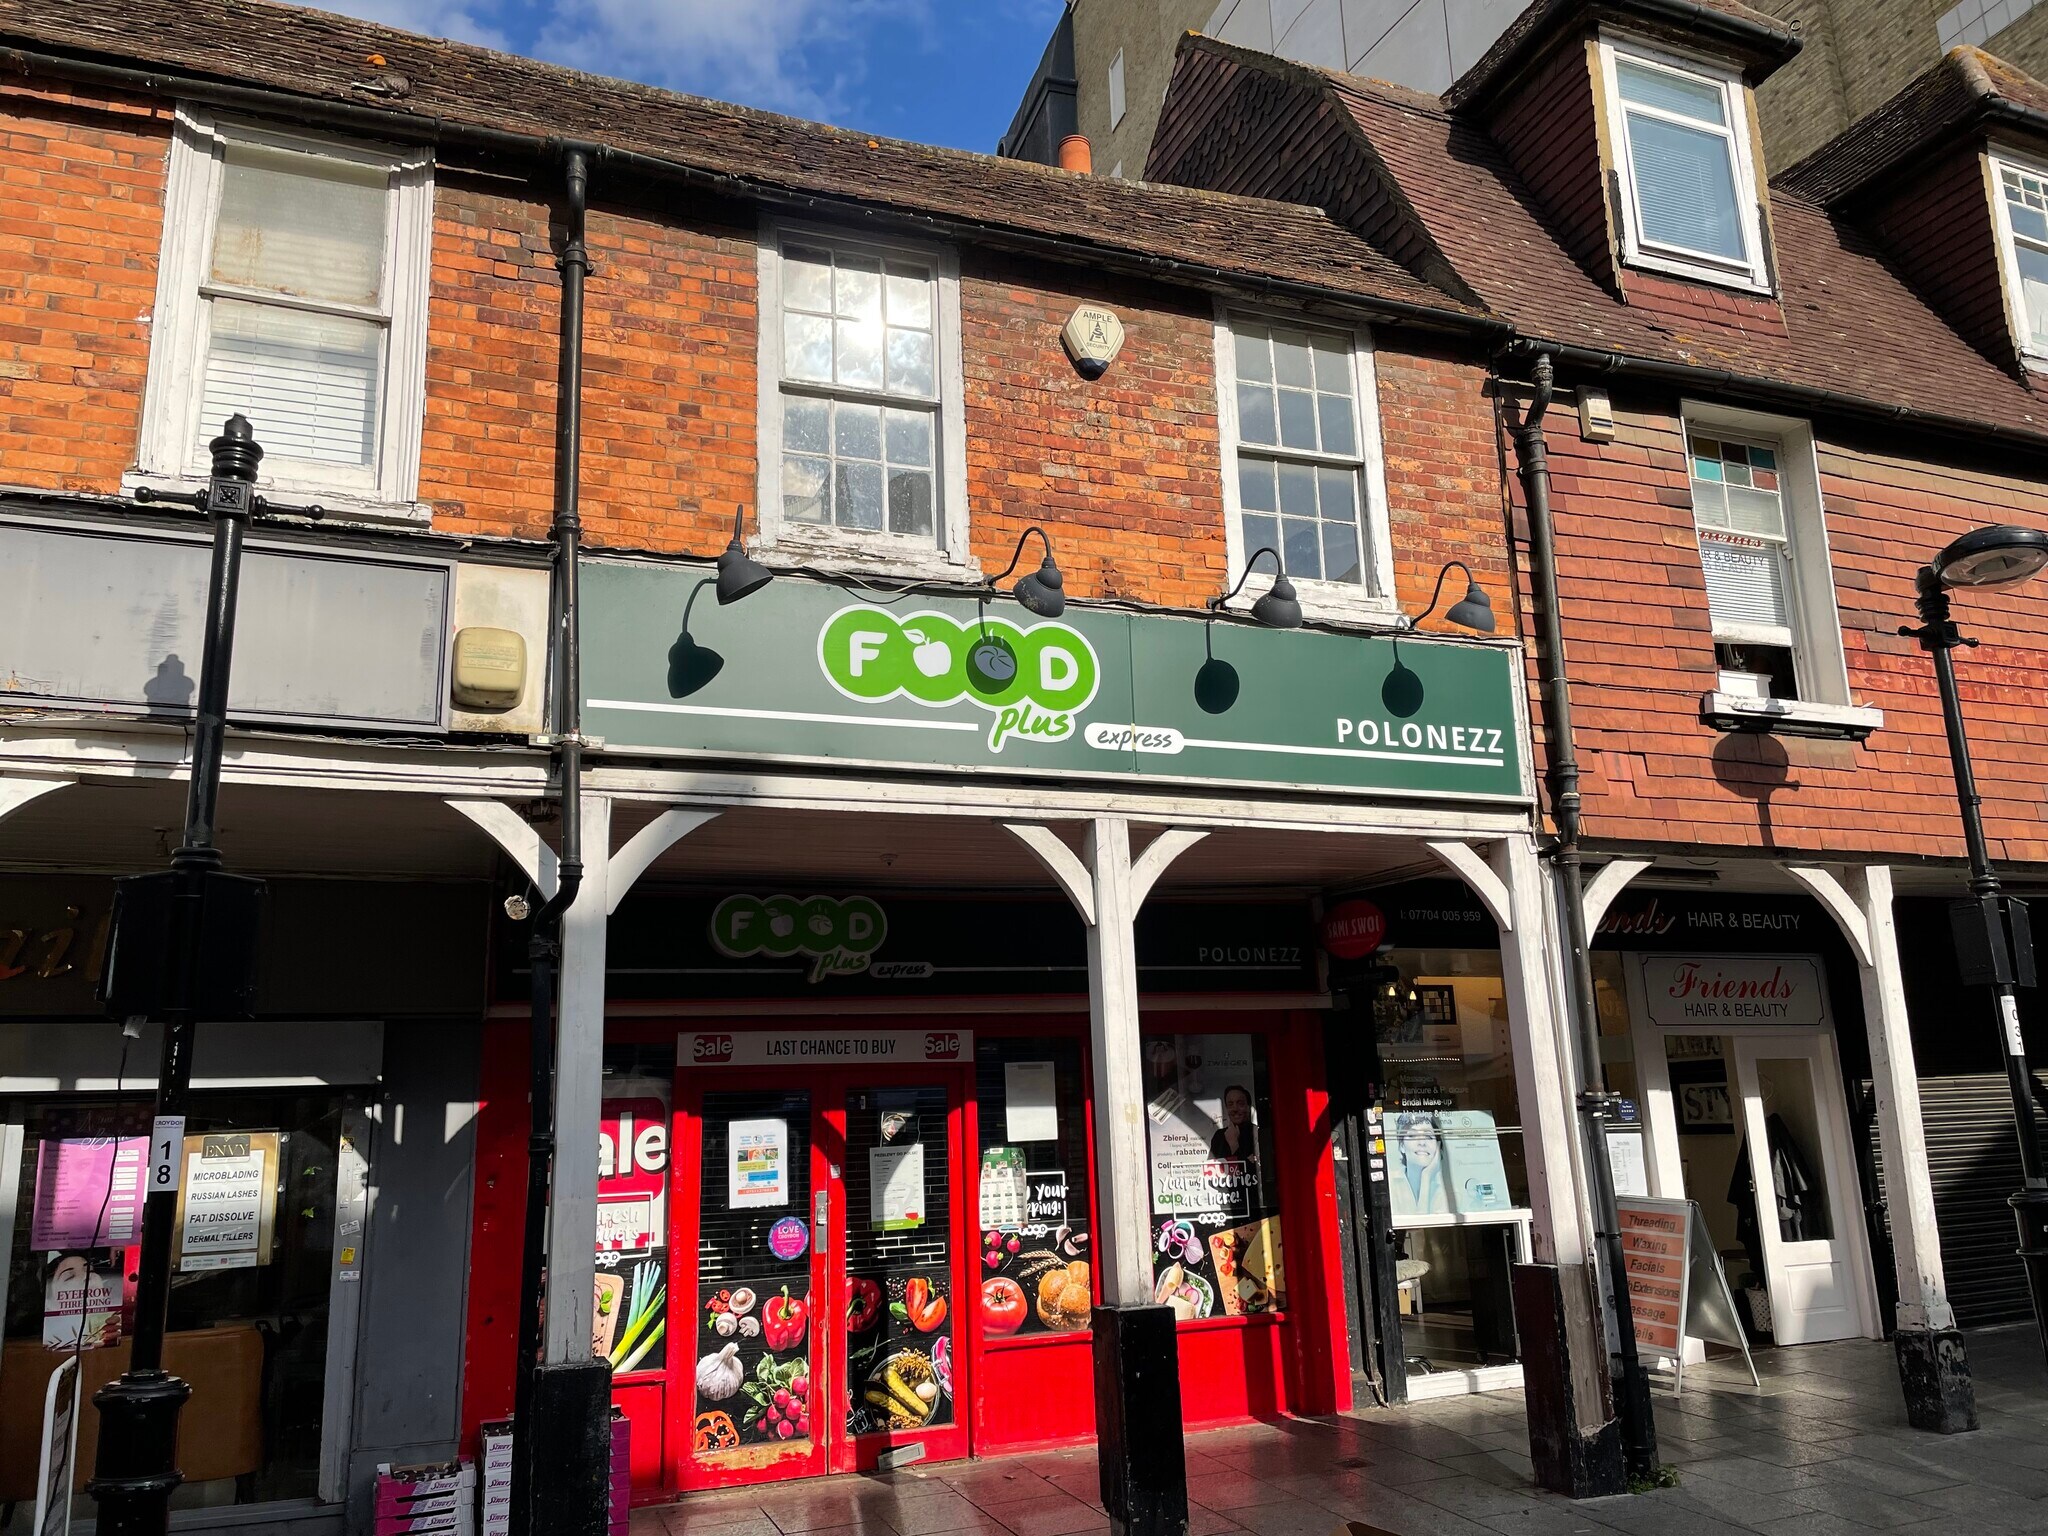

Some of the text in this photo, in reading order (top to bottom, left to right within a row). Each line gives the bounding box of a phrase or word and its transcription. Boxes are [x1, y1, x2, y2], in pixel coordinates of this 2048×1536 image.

[1083, 311, 1112, 323] AMPLE
[1725, 552, 1764, 566] BEAUTY
[849, 628, 1079, 692] FOOD
[993, 707, 1071, 747] plus
[1336, 717, 1505, 754] POLONEZZ
[1097, 727, 1173, 752] express
[731, 907, 874, 941] FOOD
[1409, 910, 1439, 921] 07704
[1442, 911, 1461, 922] 005
[1462, 911, 1481, 922] 959
[1687, 911, 1800, 929] HAIR & BEAUTY
[1327, 914, 1380, 938] SAMI SWOI
[1199, 947, 1302, 963] POLONEZZ
[816, 951, 867, 978] plus
[877, 963, 926, 978] express
[1669, 962, 1798, 999] Friends
[1684, 1003, 1788, 1018] HAIR & BEAUTY
[693, 1036, 734, 1058] Sale
[766, 1039, 896, 1056] LAST CHANCE TO BUY
[924, 1036, 960, 1055] Sale
[1402, 1097, 1453, 1107] Bridal Make-up
[597, 1111, 668, 1177] ale
[1163, 1134, 1189, 1142] Zbieraj
[206, 1144, 250, 1158] ENVY
[193, 1170, 259, 1181] MICROBLADING
[1196, 1171, 1258, 1192] groceries
[191, 1189, 258, 1201] RUSSIAN LASHES
[1035, 1183, 1069, 1201] your
[1207, 1190, 1240, 1208] here!
[189, 1211, 255, 1224] FAT DISSOLVE
[1628, 1214, 1676, 1232] Threading
[188, 1232, 254, 1244] DERMAL FILLERS
[778, 1225, 800, 1235] LOVE
[1632, 1236, 1668, 1254] Waxing
[1630, 1259, 1666, 1274] Facials
[1633, 1281, 1680, 1298] Extensions
[1631, 1305, 1666, 1319] assage
[1634, 1328, 1654, 1340] ails
